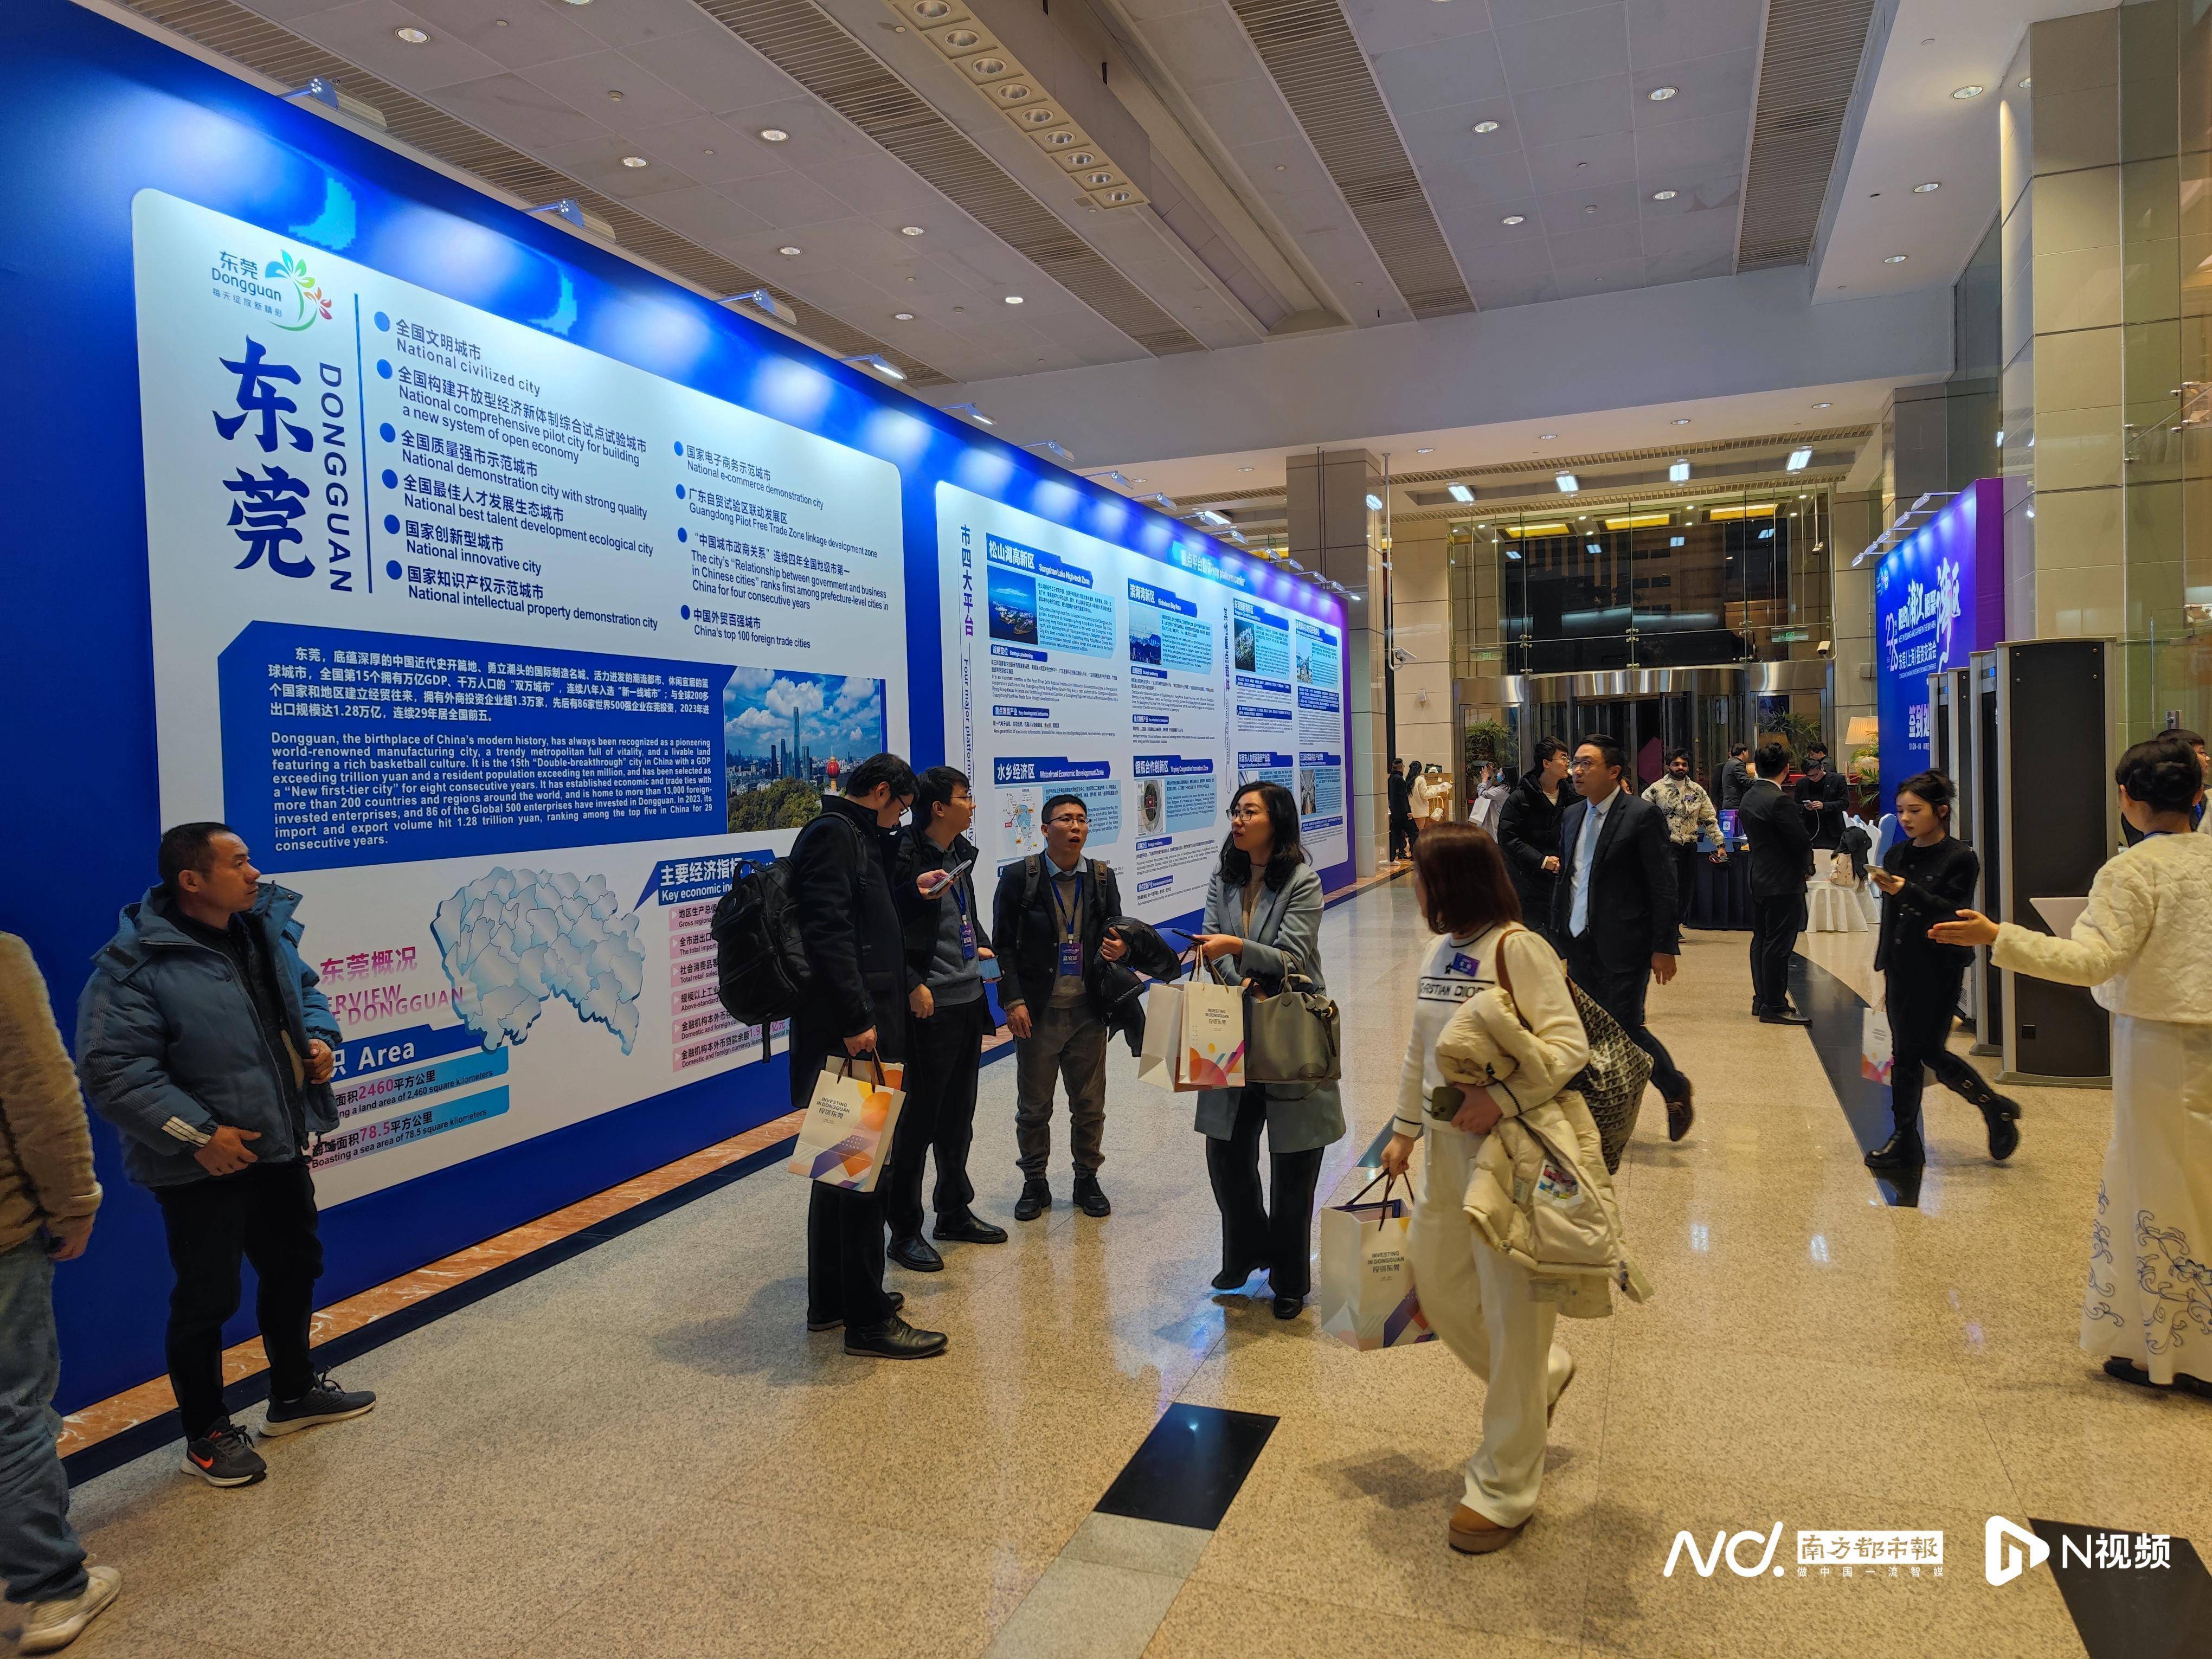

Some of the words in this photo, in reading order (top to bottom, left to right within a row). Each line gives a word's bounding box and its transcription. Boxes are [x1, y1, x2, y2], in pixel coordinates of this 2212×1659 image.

[212, 267, 281, 301] Dongguan
[218, 252, 258, 280] 东莞
[213, 287, 282, 318] 每天绽放新精彩
[396, 320, 480, 360] 全国文明城市
[397, 338, 456, 369] National
[461, 361, 515, 387] civilized
[519, 380, 539, 397] city
[398, 367, 646, 453] 全国构建开放型经济新体制综合试点试验城市
[400, 385, 450, 411] National
[454, 404, 540, 436] comprehensive
[543, 428, 565, 443] pilot
[568, 435, 584, 451] city
[587, 440, 601, 453] for
[603, 443, 639, 467] building
[403, 406, 410, 416] a
[414, 409, 439, 424] new
[442, 417, 485, 436] system
[488, 428, 499, 440] of
[502, 434, 529, 448] open
[532, 441, 578, 464] economy
[212, 335, 316, 578] 东莞
[401, 431, 537, 477] 全国质量强市示范城市
[687, 445, 770, 480] 国家电子商务示范城市
[320, 363, 352, 592] DONGGUAN
[403, 449, 453, 473] National
[457, 463, 538, 492] demonstration
[542, 484, 559, 500] city
[562, 489, 582, 503] with
[586, 495, 615, 513] strong
[618, 504, 647, 519] quality
[688, 460, 719, 478] National
[721, 472, 764, 491] e-commerce
[766, 484, 812, 505] demonstration
[813, 498, 823, 510] city
[403, 475, 563, 522] 全国最佳人才发展生态城市
[689, 488, 787, 524] 广东自贸试验区联动发展区
[404, 493, 455, 515] National
[459, 504, 484, 521] best
[487, 511, 518, 528] talent
[521, 518, 587, 541] development
[589, 535, 635, 551] ecological
[639, 543, 653, 557] city
[406, 520, 503, 551] 国家创新型城市
[690, 503, 734, 524] Guangdong
[736, 514, 751, 527] Pilot
[753, 518, 768, 531] Free
[769, 523, 787, 536] Trade
[789, 528, 805, 540] Zone
[806, 532, 827, 546] linkage
[828, 538, 864, 555] development
[865, 549, 877, 557] zone
[407, 539, 458, 560] National
[461, 549, 519, 569] innovative
[523, 560, 541, 575] city
[989, 540, 1035, 570] 松山湖高新区
[408, 565, 543, 600] 国家知识产权示范城市
[691, 550, 706, 563] The
[709, 554, 729, 568] city’s
[731, 558, 780, 578] “Relationship
[782, 568, 810, 583] between
[812, 577, 848, 591] government
[850, 584, 860, 593] and
[861, 585, 886, 598] business
[961, 524, 973, 636] 市四大平台
[409, 584, 459, 603] National
[463, 592, 524, 612] intellectual
[528, 604, 570, 620] property
[574, 608, 640, 626] demonstration
[643, 618, 658, 631] city
[694, 608, 760, 629] 中国外贸百强城市
[695, 625, 722, 638] China's
[724, 629, 736, 641] top
[738, 631, 749, 641] 100
[751, 632, 775, 645] foreign
[776, 636, 793, 646] trade
[794, 638, 810, 648] cities
[272, 732, 339, 747] Dongguan,
[343, 734, 361, 743] the
[365, 734, 420, 748] birthplace
[424, 735, 434, 748] of
[437, 735, 474, 748] China’s
[478, 736, 512, 748] modern
[516, 736, 549, 748] history,
[551, 736, 566, 745] has
[567, 737, 596, 749] always
[598, 737, 616, 745] been
[619, 738, 659, 749] recognized
[674, 738, 710, 749] pioneering
[997, 763, 1035, 781] 水乡经济区
[663, 890, 679, 901] Key
[681, 884, 721, 898] economic
[318, 946, 417, 985] 东莞概况
[348, 987, 462, 1024] DONGGUAN
[681, 998, 718, 1012] Above-standard
[358, 1043, 414, 1070] Area
[682, 1056, 704, 1068] Domestic
[705, 1052, 714, 1060] and
[715, 1049, 731, 1057] foreign
[732, 1042, 750, 1052] currency
[359, 1100, 376, 1113] land
[379, 1097, 396, 1107] area
[398, 1092, 406, 1101] of
[407, 1086, 428, 1099] 2,460
[429, 1082, 455, 1093] square
[455, 1071, 493, 1087] kilometers
[822, 1097, 847, 1107] INVESTING
[822, 1102, 850, 1113] DONGGUAN
[311, 1151, 351, 1168] Boasting
[360, 1144, 374, 1153] sea
[377, 1139, 394, 1148] area
[396, 1133, 403, 1142] of
[406, 1128, 421, 1139] 78.5
[423, 1122, 448, 1134] square
[450, 1110, 486, 1126] kilometers
